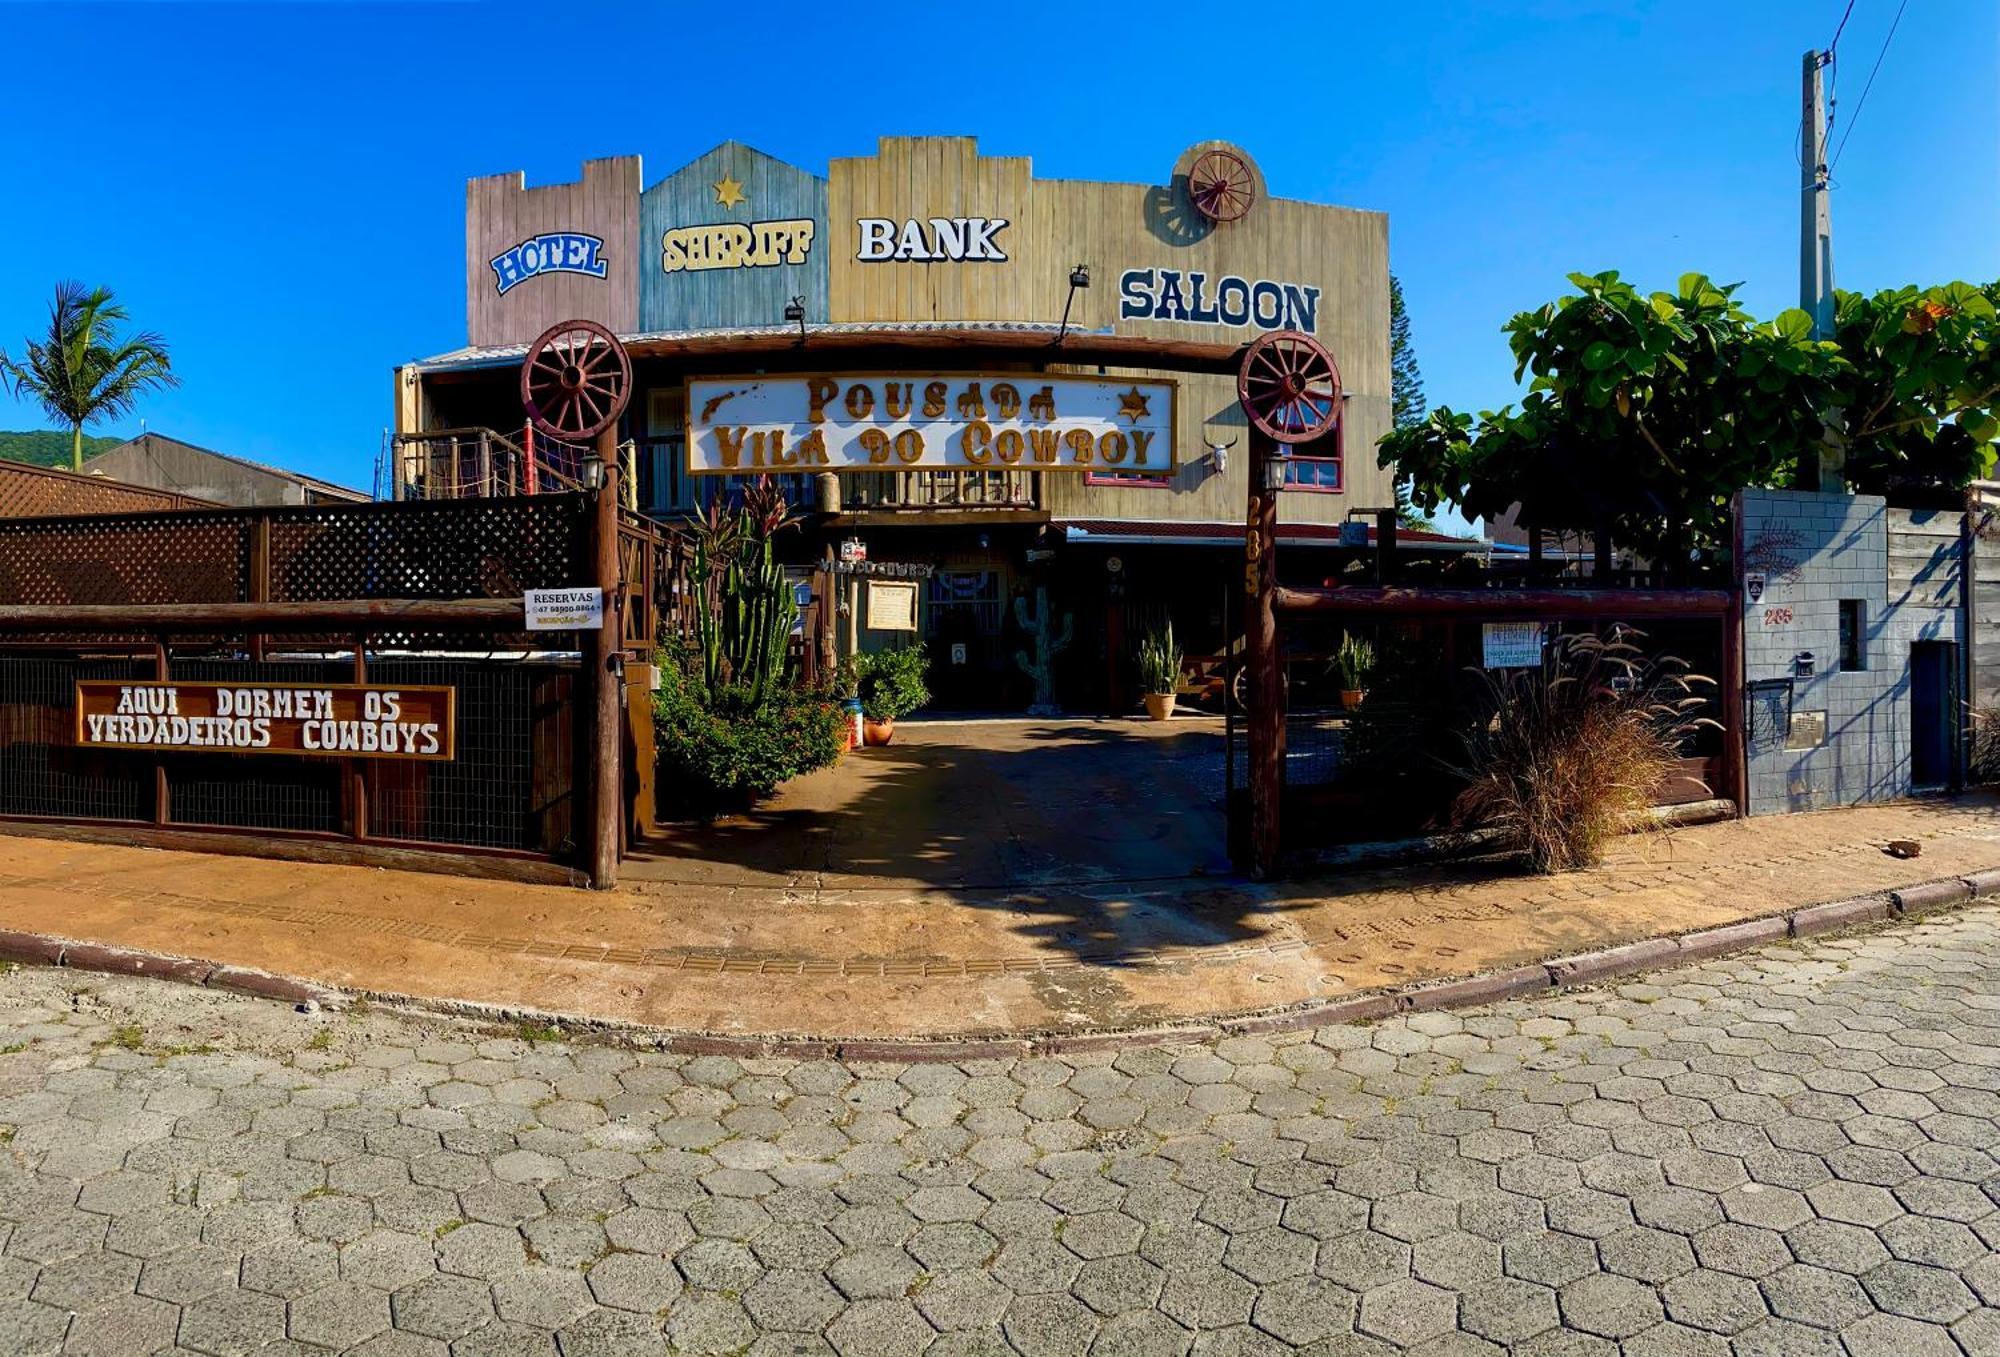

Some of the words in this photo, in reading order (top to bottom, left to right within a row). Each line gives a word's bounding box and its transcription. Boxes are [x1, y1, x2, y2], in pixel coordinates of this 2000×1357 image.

[490, 231, 608, 296] HOTEL
[663, 219, 815, 273] SHERIFF
[856, 217, 1010, 264] BANK
[1120, 268, 1320, 334] SALOON
[807, 378, 1057, 425] POUSADA
[713, 426, 830, 468] VILA
[860, 427, 926, 466] DO
[960, 419, 1156, 467] COWBOY
[1245, 496, 1261, 595] 285
[533, 592, 593, 604] RESERVAS
[117, 686, 179, 715] AQUI
[217, 688, 334, 720] DORMEM
[364, 691, 401, 722] OS
[88, 714, 271, 748] VERDADEIROS
[303, 719, 440, 755] COWBOYS
